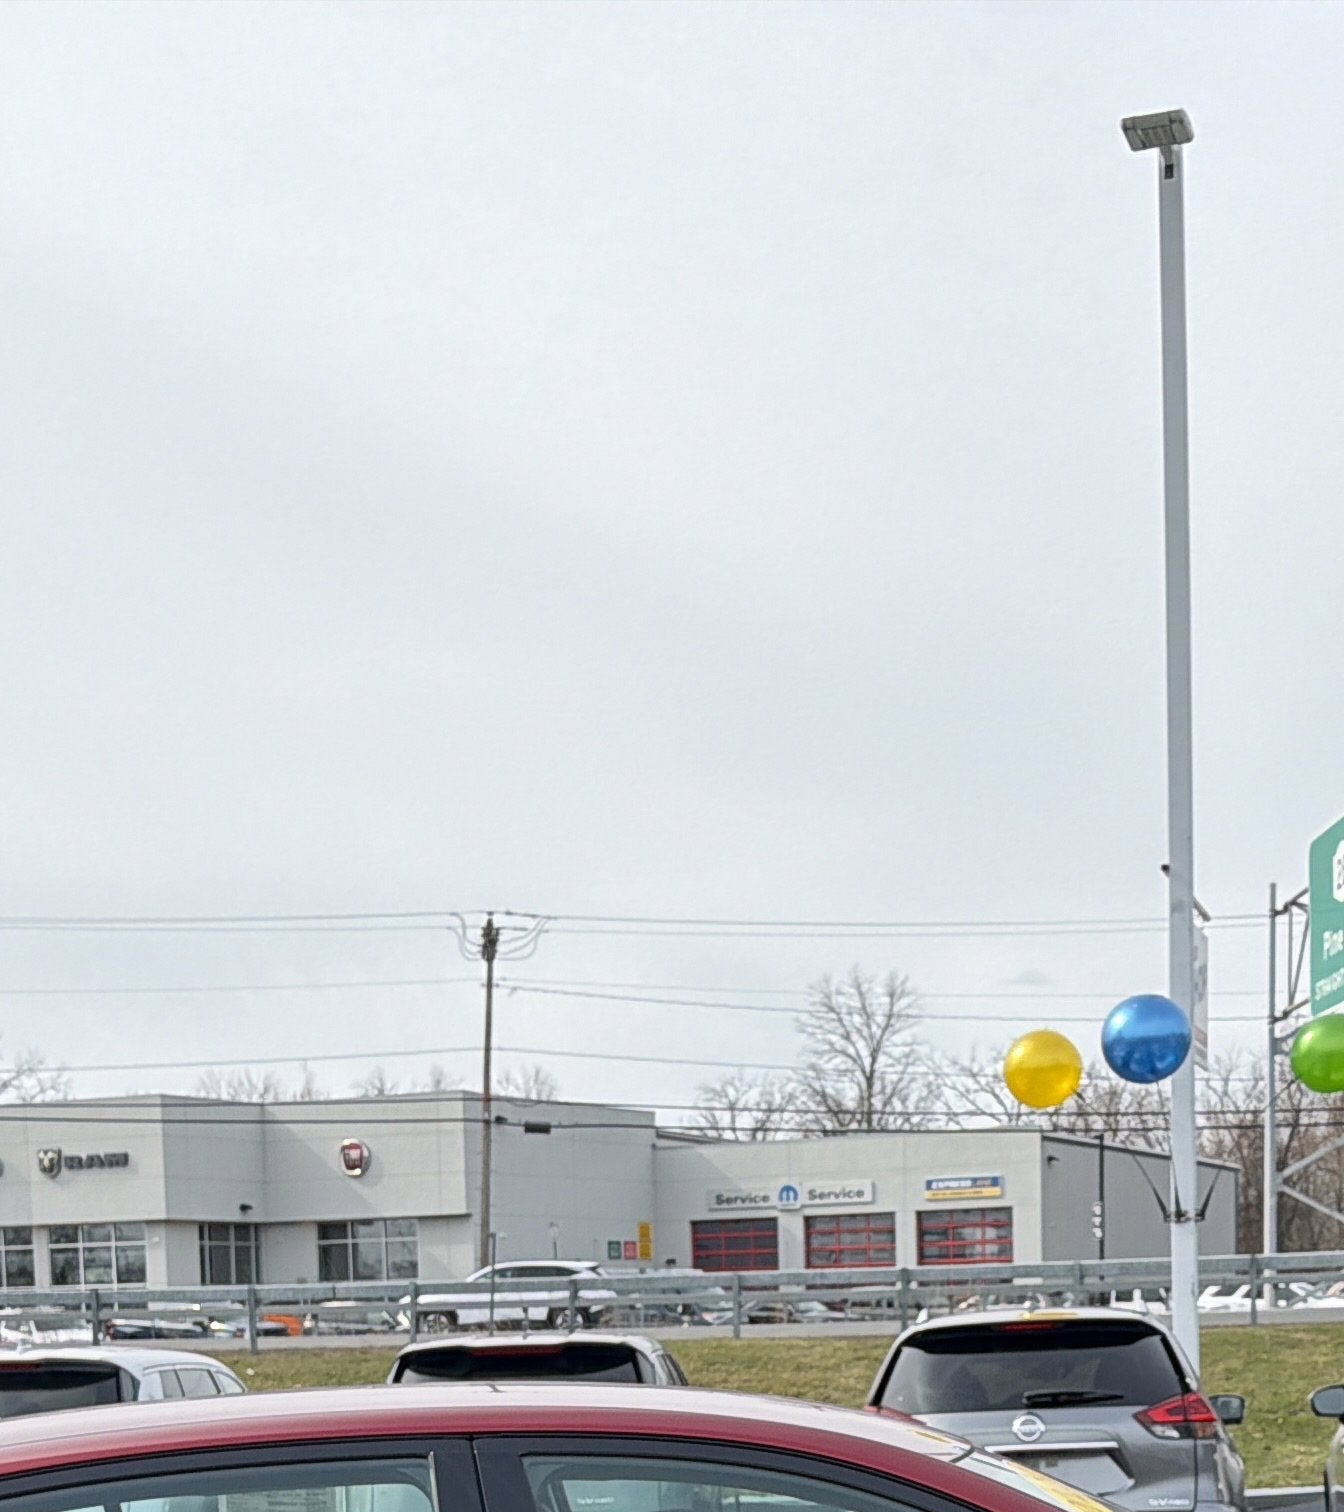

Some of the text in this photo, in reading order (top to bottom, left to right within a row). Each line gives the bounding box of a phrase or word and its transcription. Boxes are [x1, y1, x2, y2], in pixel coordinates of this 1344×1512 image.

[64, 1152, 130, 1170] RAM
[715, 1193, 770, 1206] Service
[808, 1187, 865, 1202] Service
